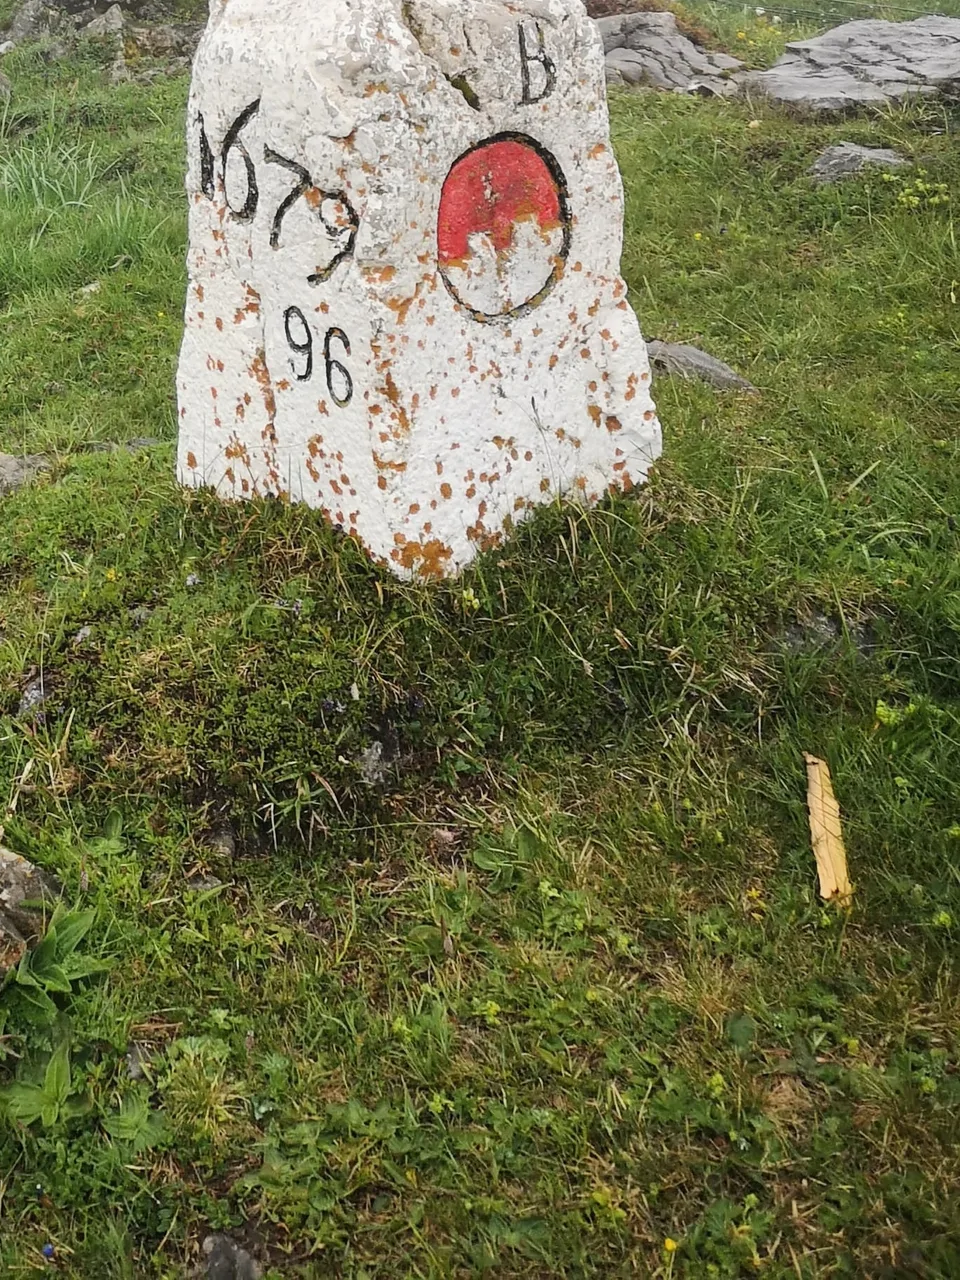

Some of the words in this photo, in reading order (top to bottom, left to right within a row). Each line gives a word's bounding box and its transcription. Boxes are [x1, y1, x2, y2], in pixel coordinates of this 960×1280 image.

[518, 20, 557, 106] B
[197, 98, 360, 286] 1679
[283, 305, 353, 408] 96
